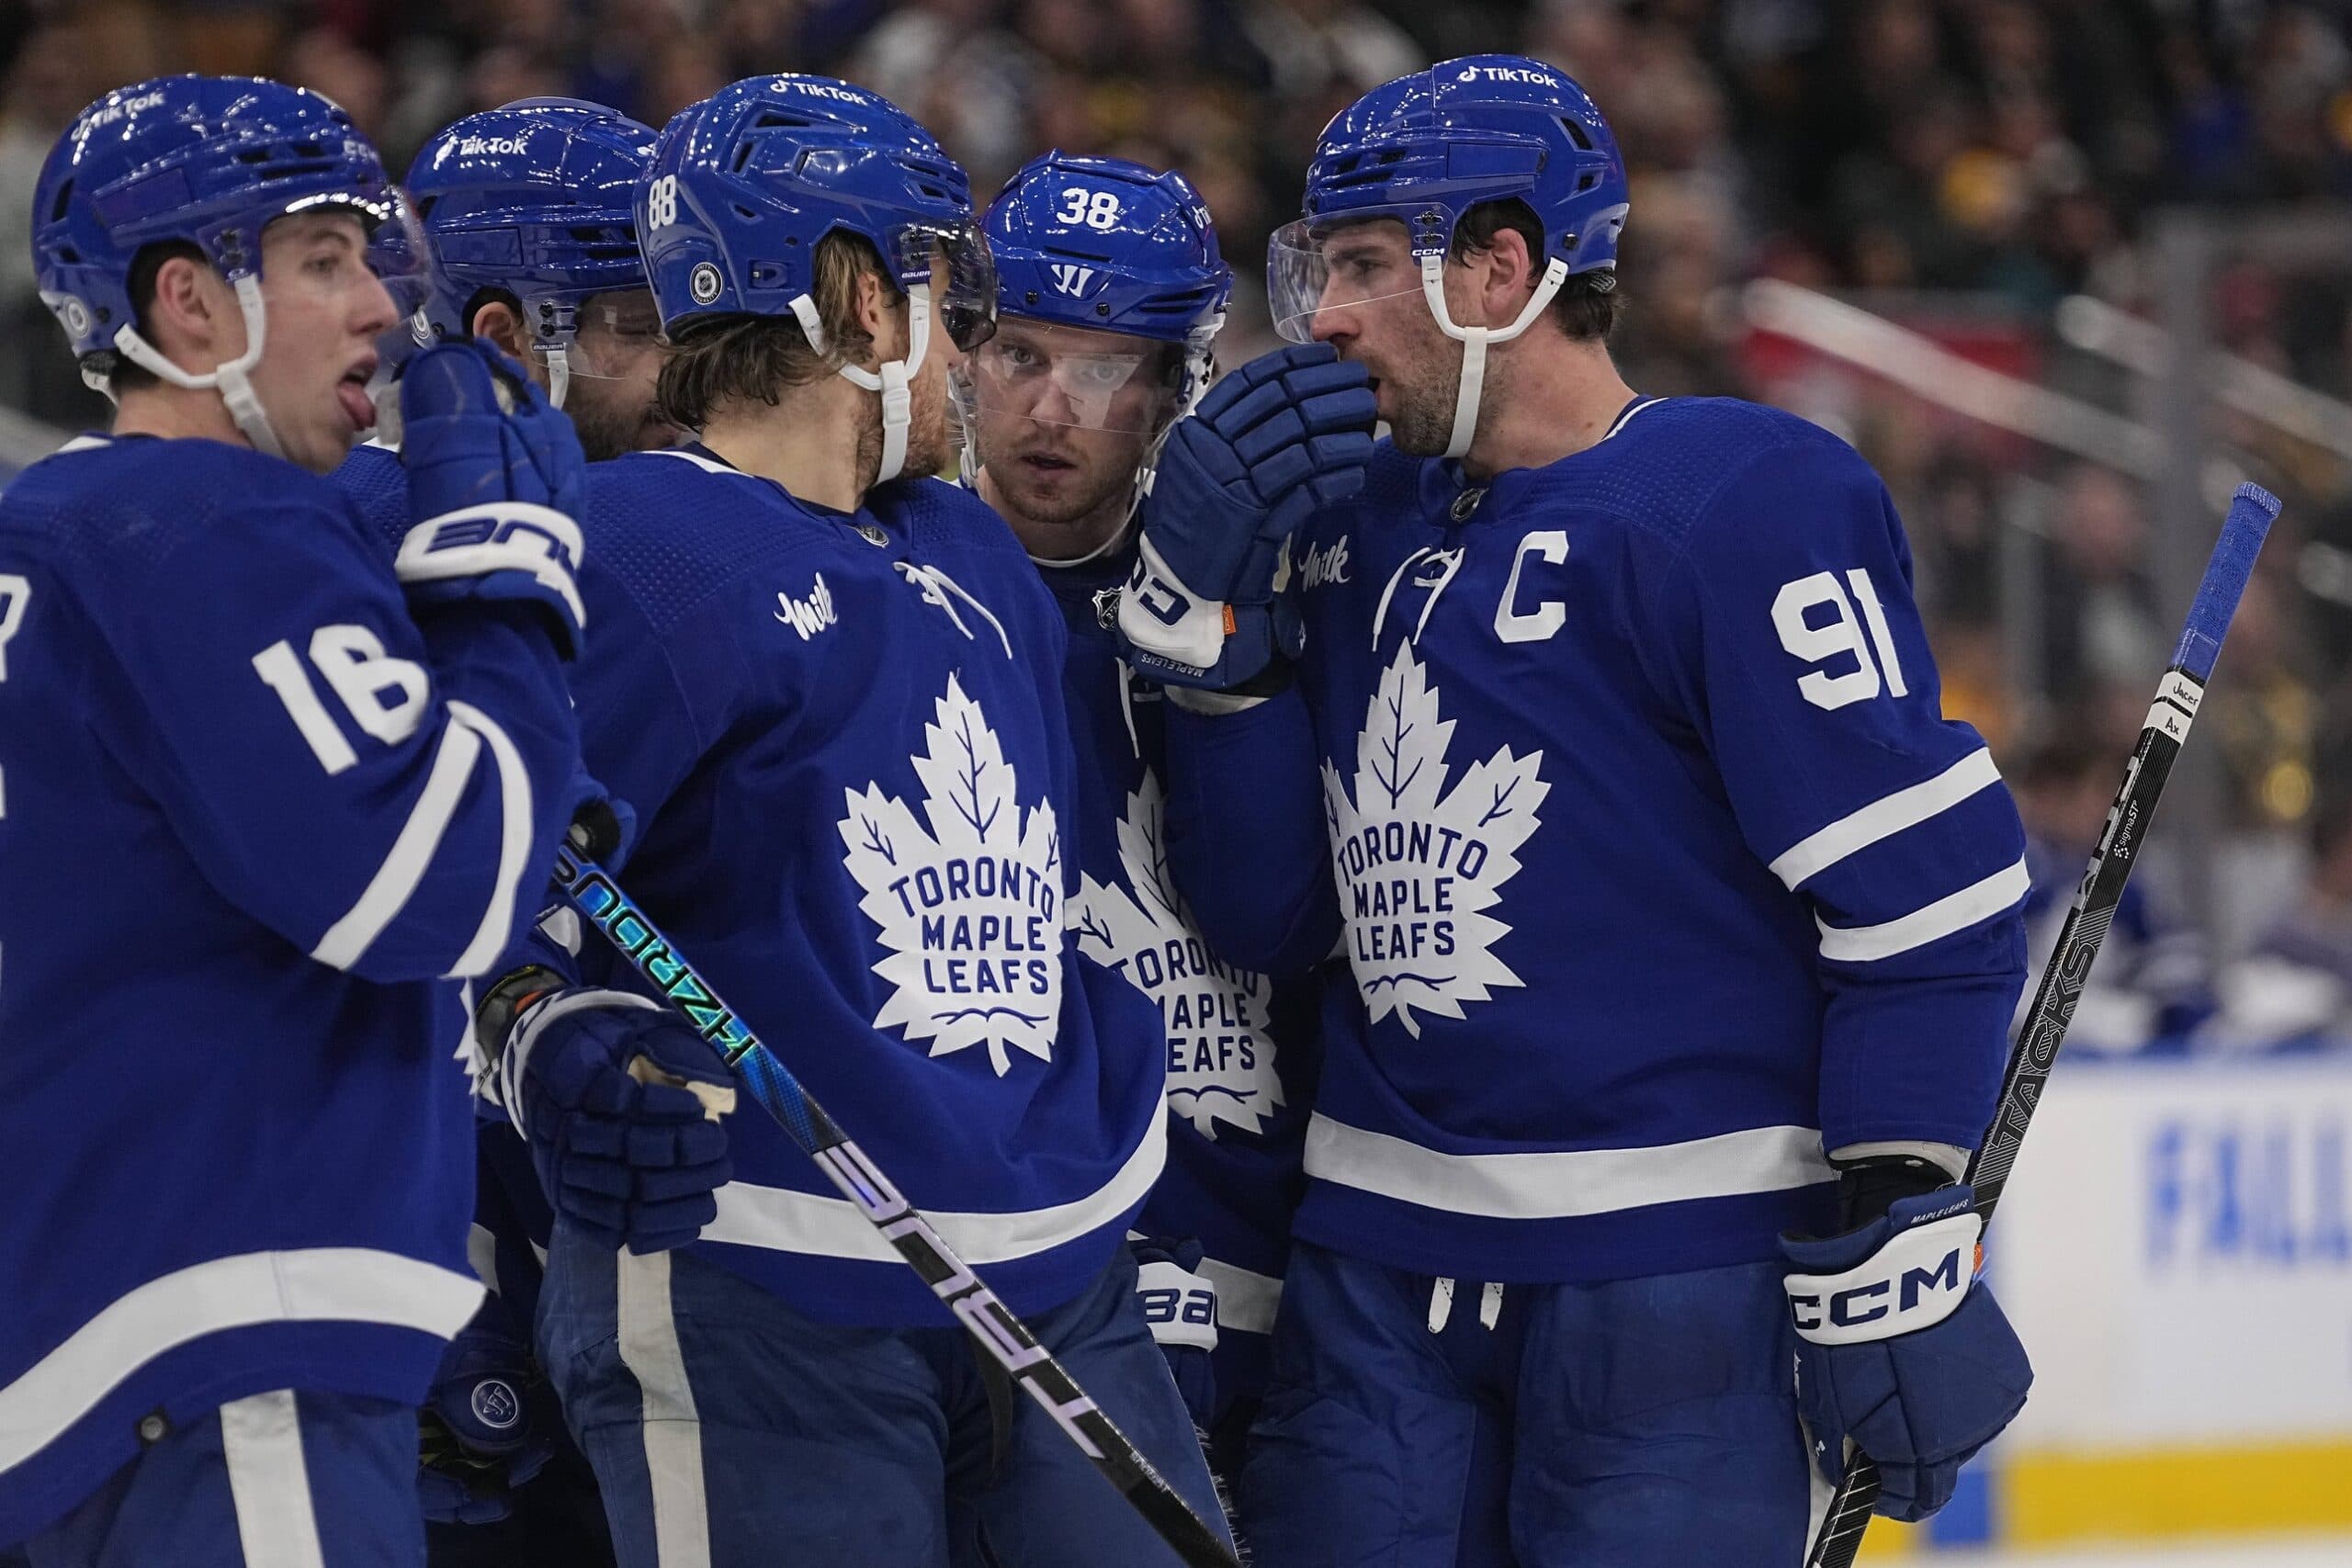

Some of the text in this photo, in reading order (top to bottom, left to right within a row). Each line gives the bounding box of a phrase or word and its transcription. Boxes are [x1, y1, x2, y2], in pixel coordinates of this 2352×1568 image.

[793, 82, 867, 106] TikTok
[1484, 68, 1559, 88] TikTok
[89, 92, 165, 128] TikTok
[460, 138, 526, 155] TikTok
[649, 175, 676, 230] 88
[1057, 187, 1120, 229] 38
[1412, 248, 1445, 256] CCM
[1298, 535, 1351, 592] Milk
[1494, 531, 1569, 643] C
[1770, 568, 1908, 711] 91
[1141, 653, 1205, 677] MAPLE LEAFS
[252, 624, 430, 775] 16
[1338, 821, 1488, 886] TORONTO
[888, 856, 1054, 922] TORONTO
[1353, 876, 1453, 919] MAPLE
[922, 914, 1046, 951] MAPLE
[1357, 920, 1454, 962] LEAFS
[923, 959, 1048, 995] LEAFS
[1990, 936, 2097, 1149] TACKS
[1911, 1199, 1969, 1224] MAPLE LEAFS
[813, 1140, 1106, 1460] TRUE
[1789, 1248, 1960, 1330] CCM
